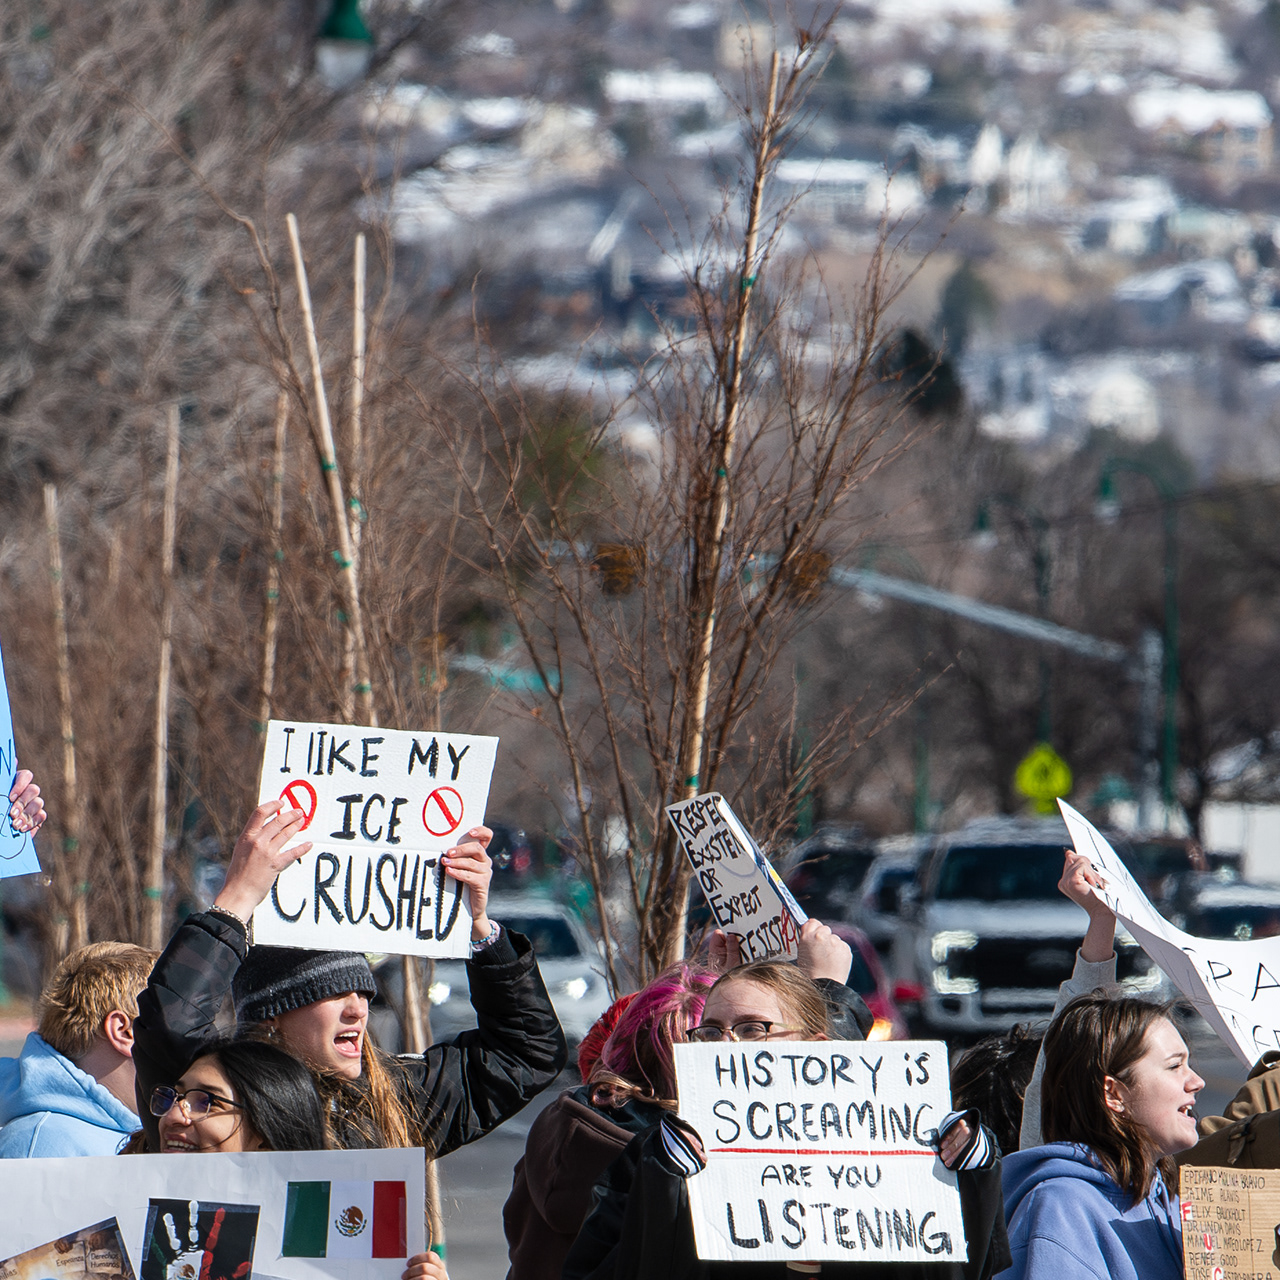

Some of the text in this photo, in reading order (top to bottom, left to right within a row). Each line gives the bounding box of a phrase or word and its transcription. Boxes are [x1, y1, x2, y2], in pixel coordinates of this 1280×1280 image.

[279, 727, 296, 774] I
[407, 736, 471, 781] MY
[329, 793, 410, 845] ICE
[271, 850, 464, 942] CRUSHED
[699, 867, 724, 894] OR
[710, 884, 764, 928] EXPECT
[714, 1050, 884, 1097] HISTORY
[712, 1099, 939, 1147] SCREAMING
[760, 1164, 882, 1189] ARE YOU
[1181, 1201, 1212, 1221] FELIX
[1184, 1186, 1215, 1203] JAIME
[726, 1198, 953, 1256] LISTENING
[1186, 1220, 1201, 1233] DR
[1201, 1220, 1224, 1234] LINDA
[1186, 1232, 1222, 1251] MANUEL
[1188, 1251, 1239, 1268] RENEE GOOD
